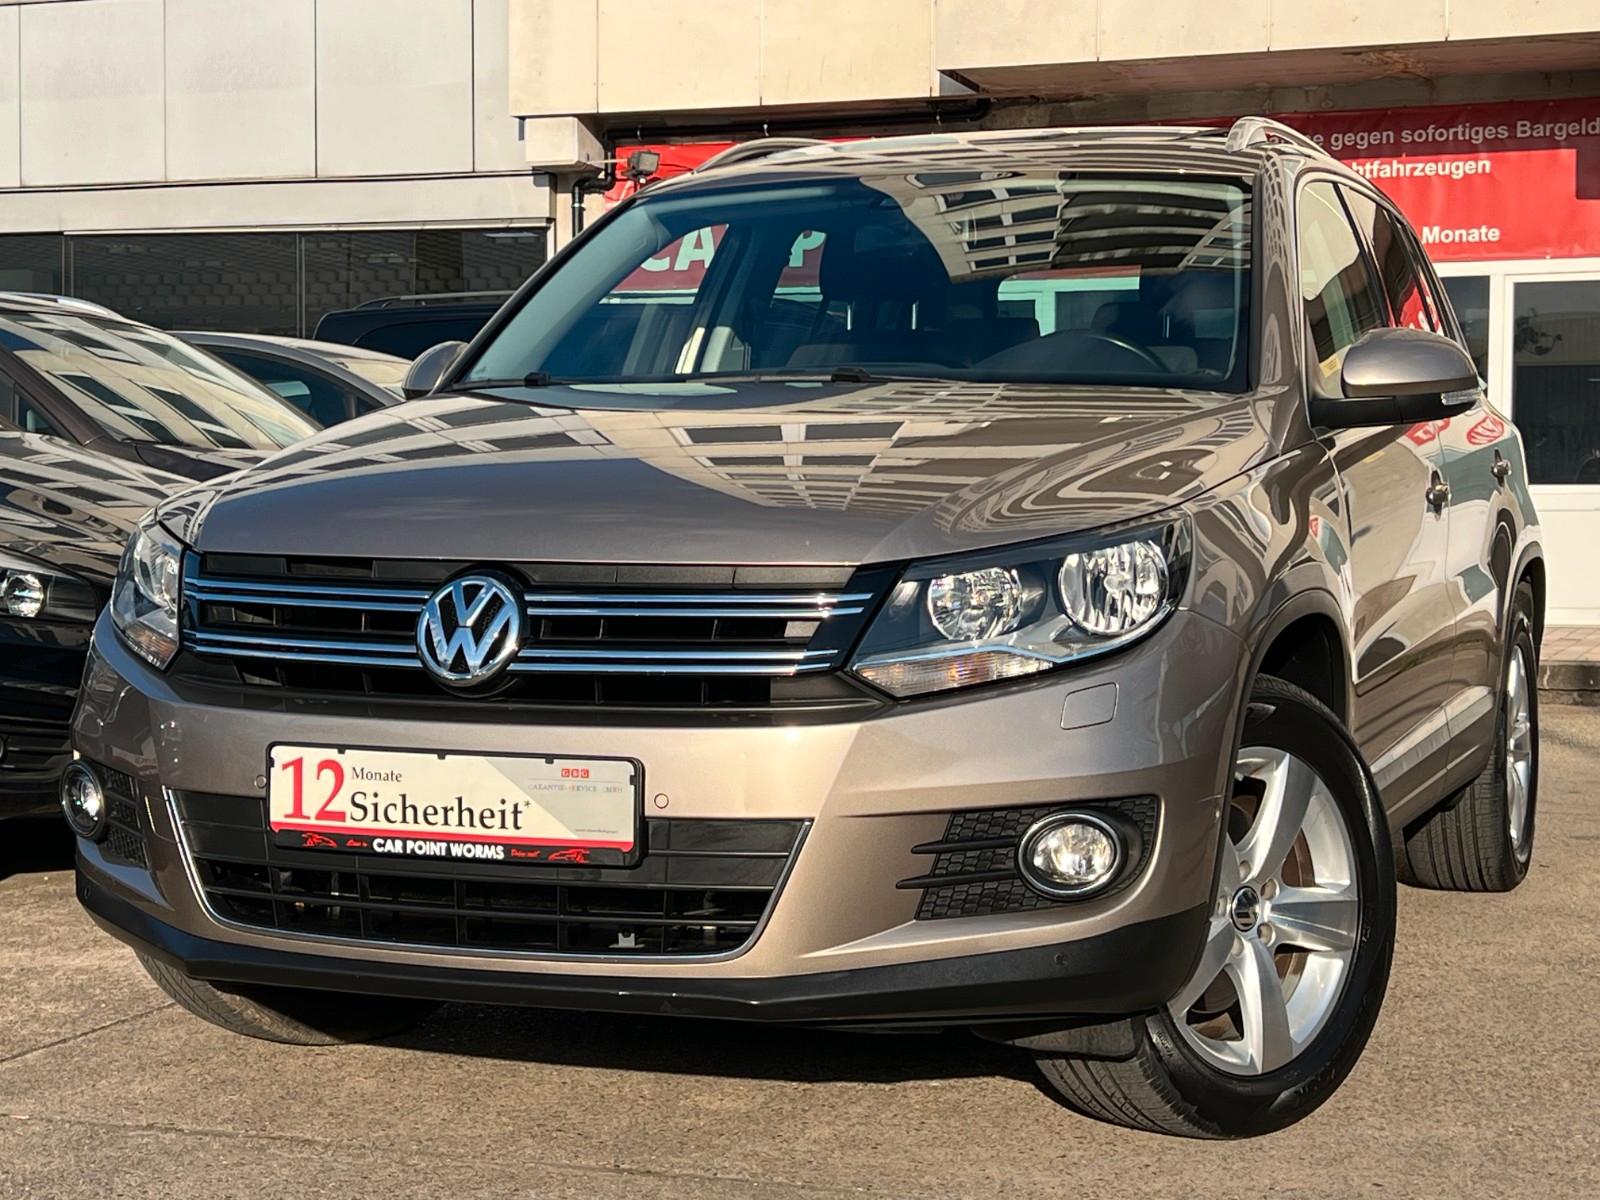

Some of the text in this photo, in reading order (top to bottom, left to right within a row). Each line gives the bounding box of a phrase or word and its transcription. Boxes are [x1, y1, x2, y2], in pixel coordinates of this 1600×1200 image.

[1330, 131, 1394, 150] gegen
[1401, 122, 1508, 145] sofortiges
[1516, 117, 1600, 141] Bargeld
[1421, 225, 1501, 244] Monate
[281, 756, 402, 823] 12 Monate
[372, 838, 403, 854] CAR
[406, 840, 447, 857] POINT
[450, 843, 504, 859] WORMS
